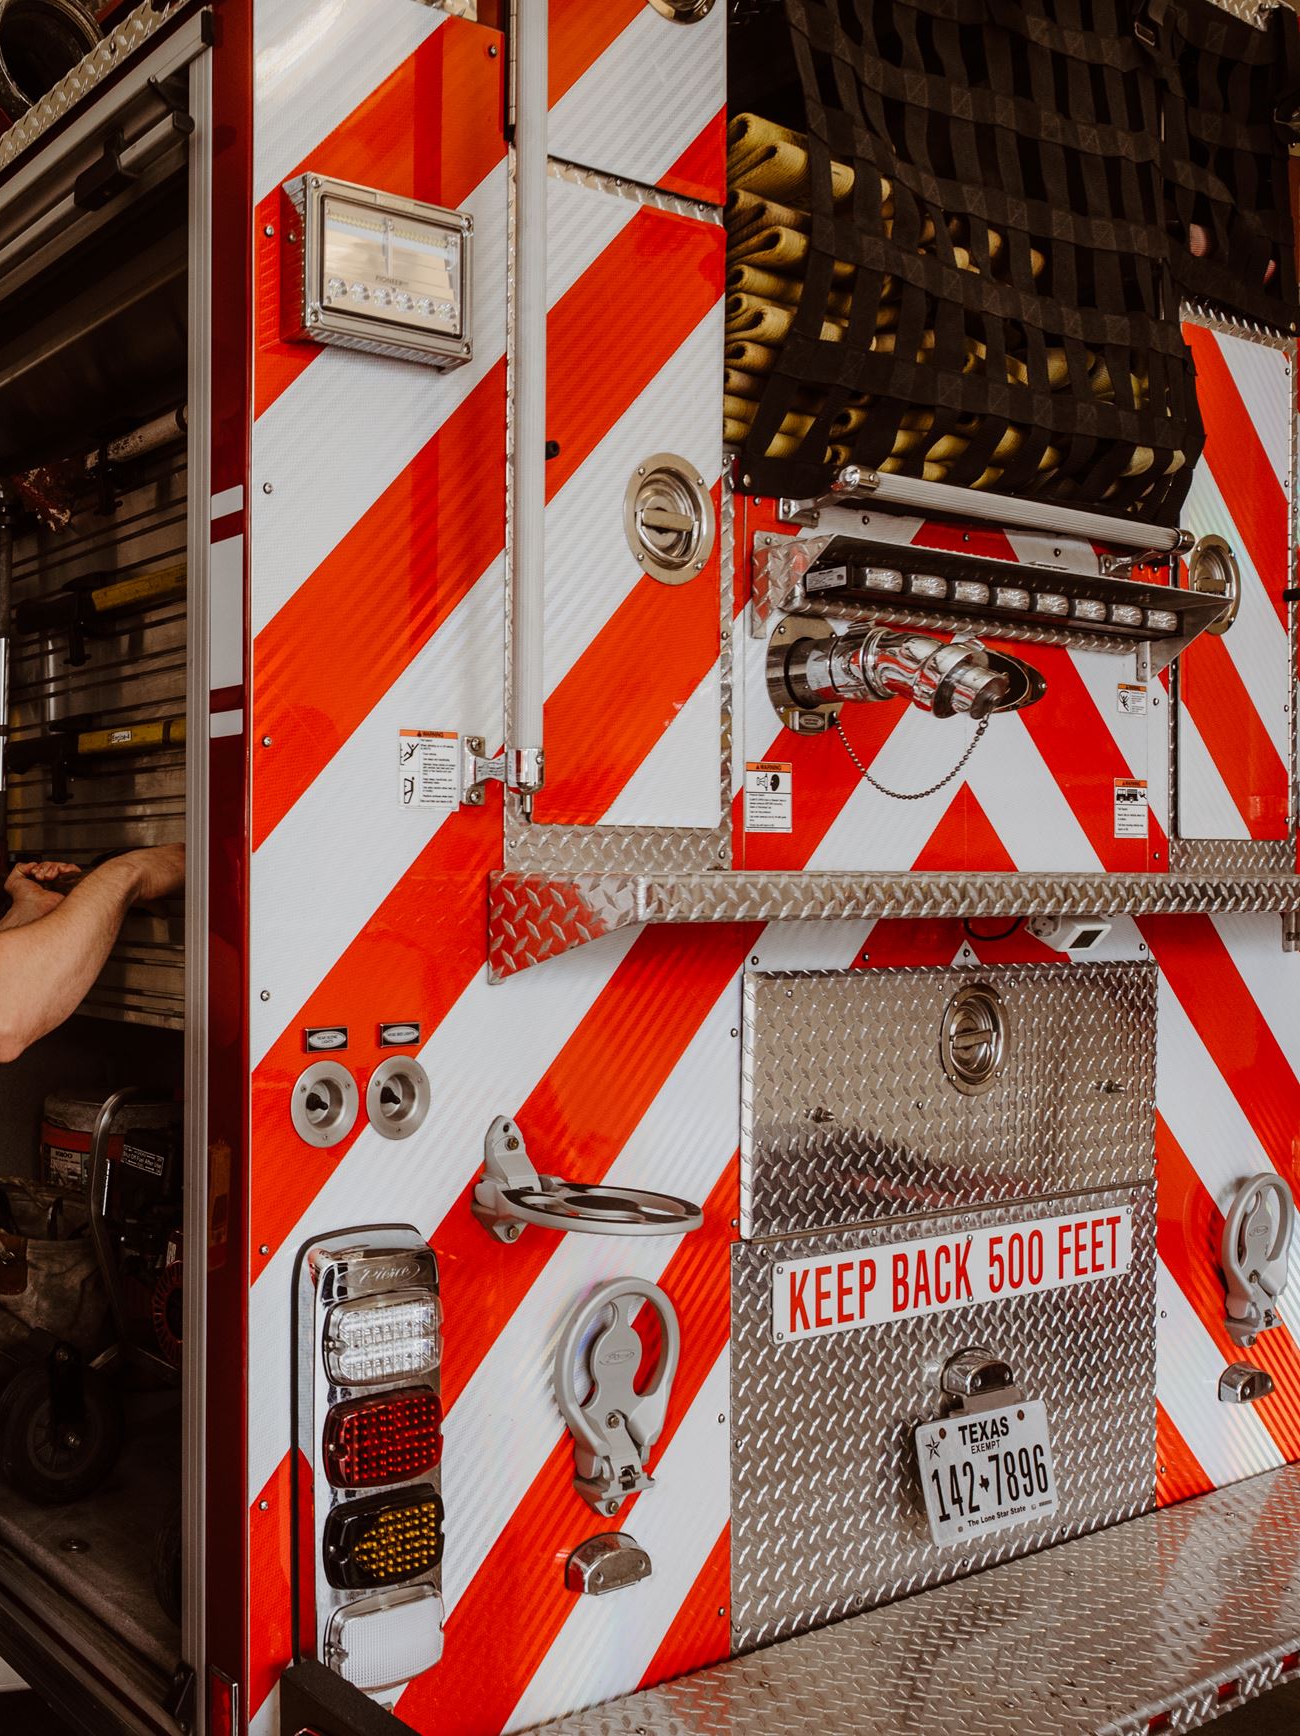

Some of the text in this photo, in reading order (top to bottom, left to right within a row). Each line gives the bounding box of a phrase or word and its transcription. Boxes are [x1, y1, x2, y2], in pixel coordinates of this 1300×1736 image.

[375, 275, 402, 286] PIONEER
[359, 1265, 411, 1284] Pierce
[789, 1215, 1121, 1333] KEEP BACK 500 FEET
[958, 1416, 1009, 1445] TEXAS
[970, 1440, 1000, 1455] EXEMPT
[967, 1505, 1027, 1528] The Lone Star State
